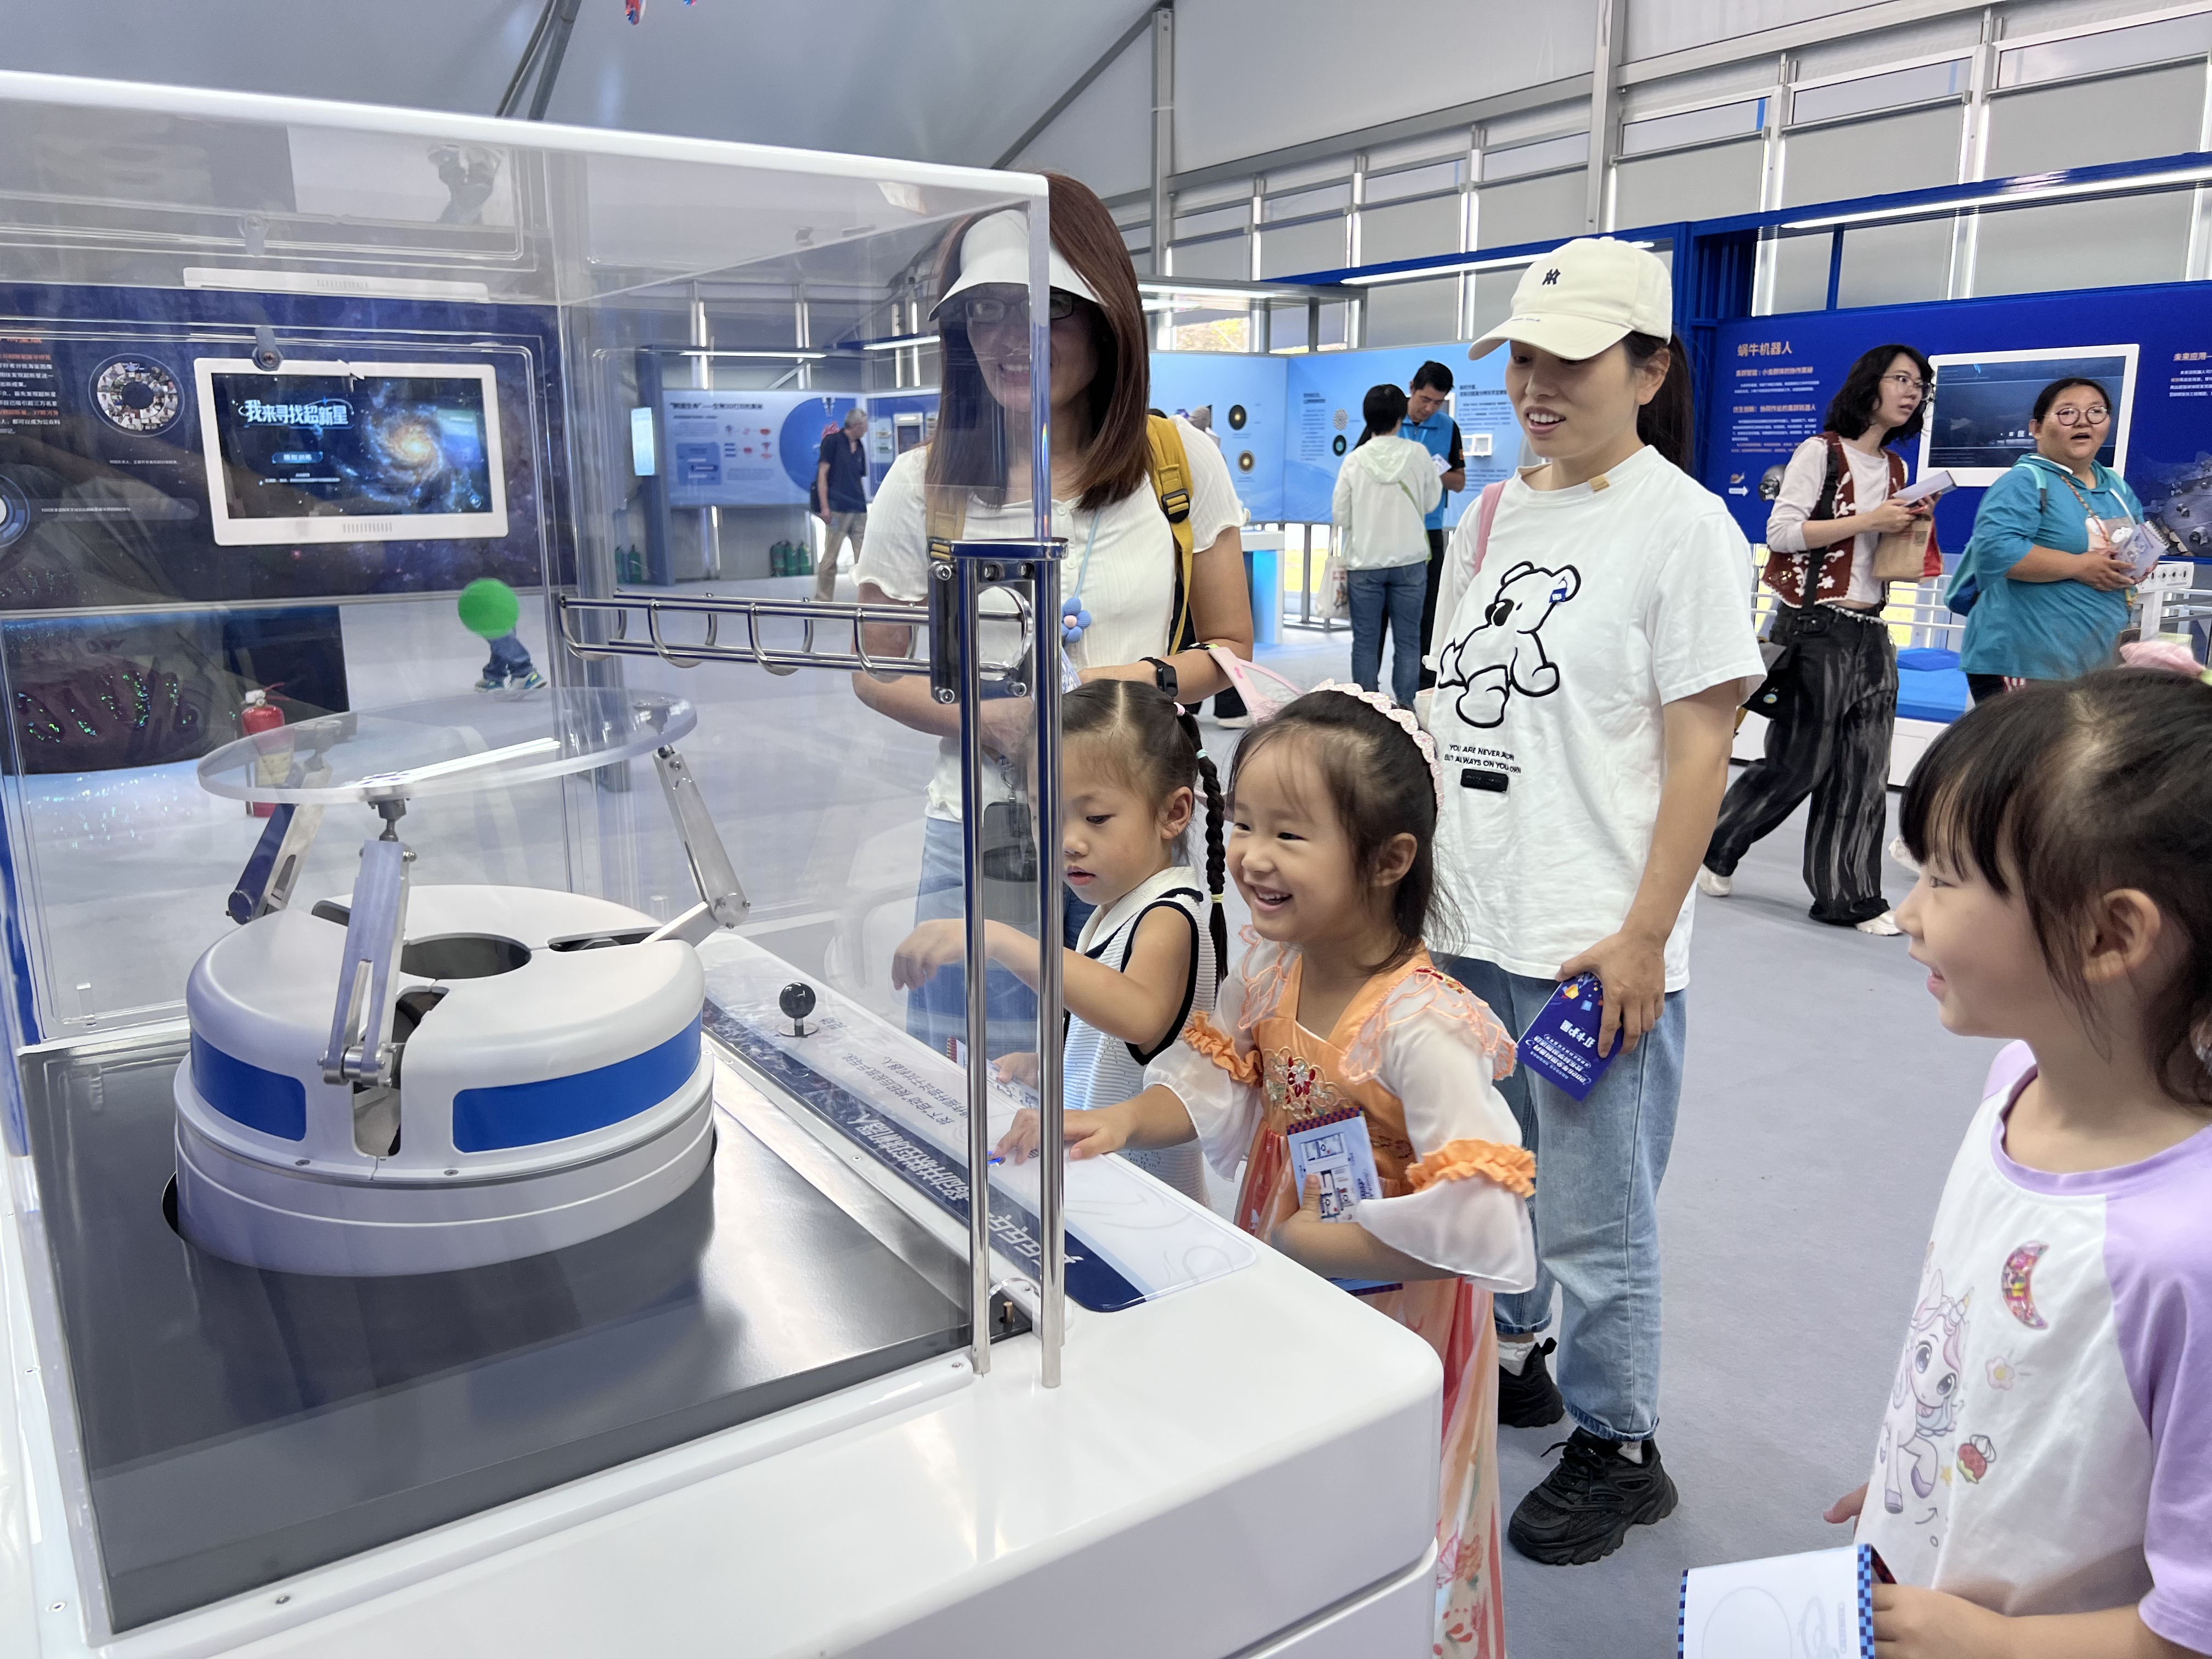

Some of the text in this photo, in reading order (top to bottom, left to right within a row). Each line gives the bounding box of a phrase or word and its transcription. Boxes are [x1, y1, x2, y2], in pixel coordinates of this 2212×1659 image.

[1737, 341, 1792, 357] 蜗牛机器人
[245, 399, 348, 425] 我来寻找超新星
[1477, 748, 1500, 757] NEVER
[1455, 757, 1481, 766] ALWAYS
[1495, 761, 1509, 771] YOU
[1559, 1019, 1595, 1049] 打卡护照
